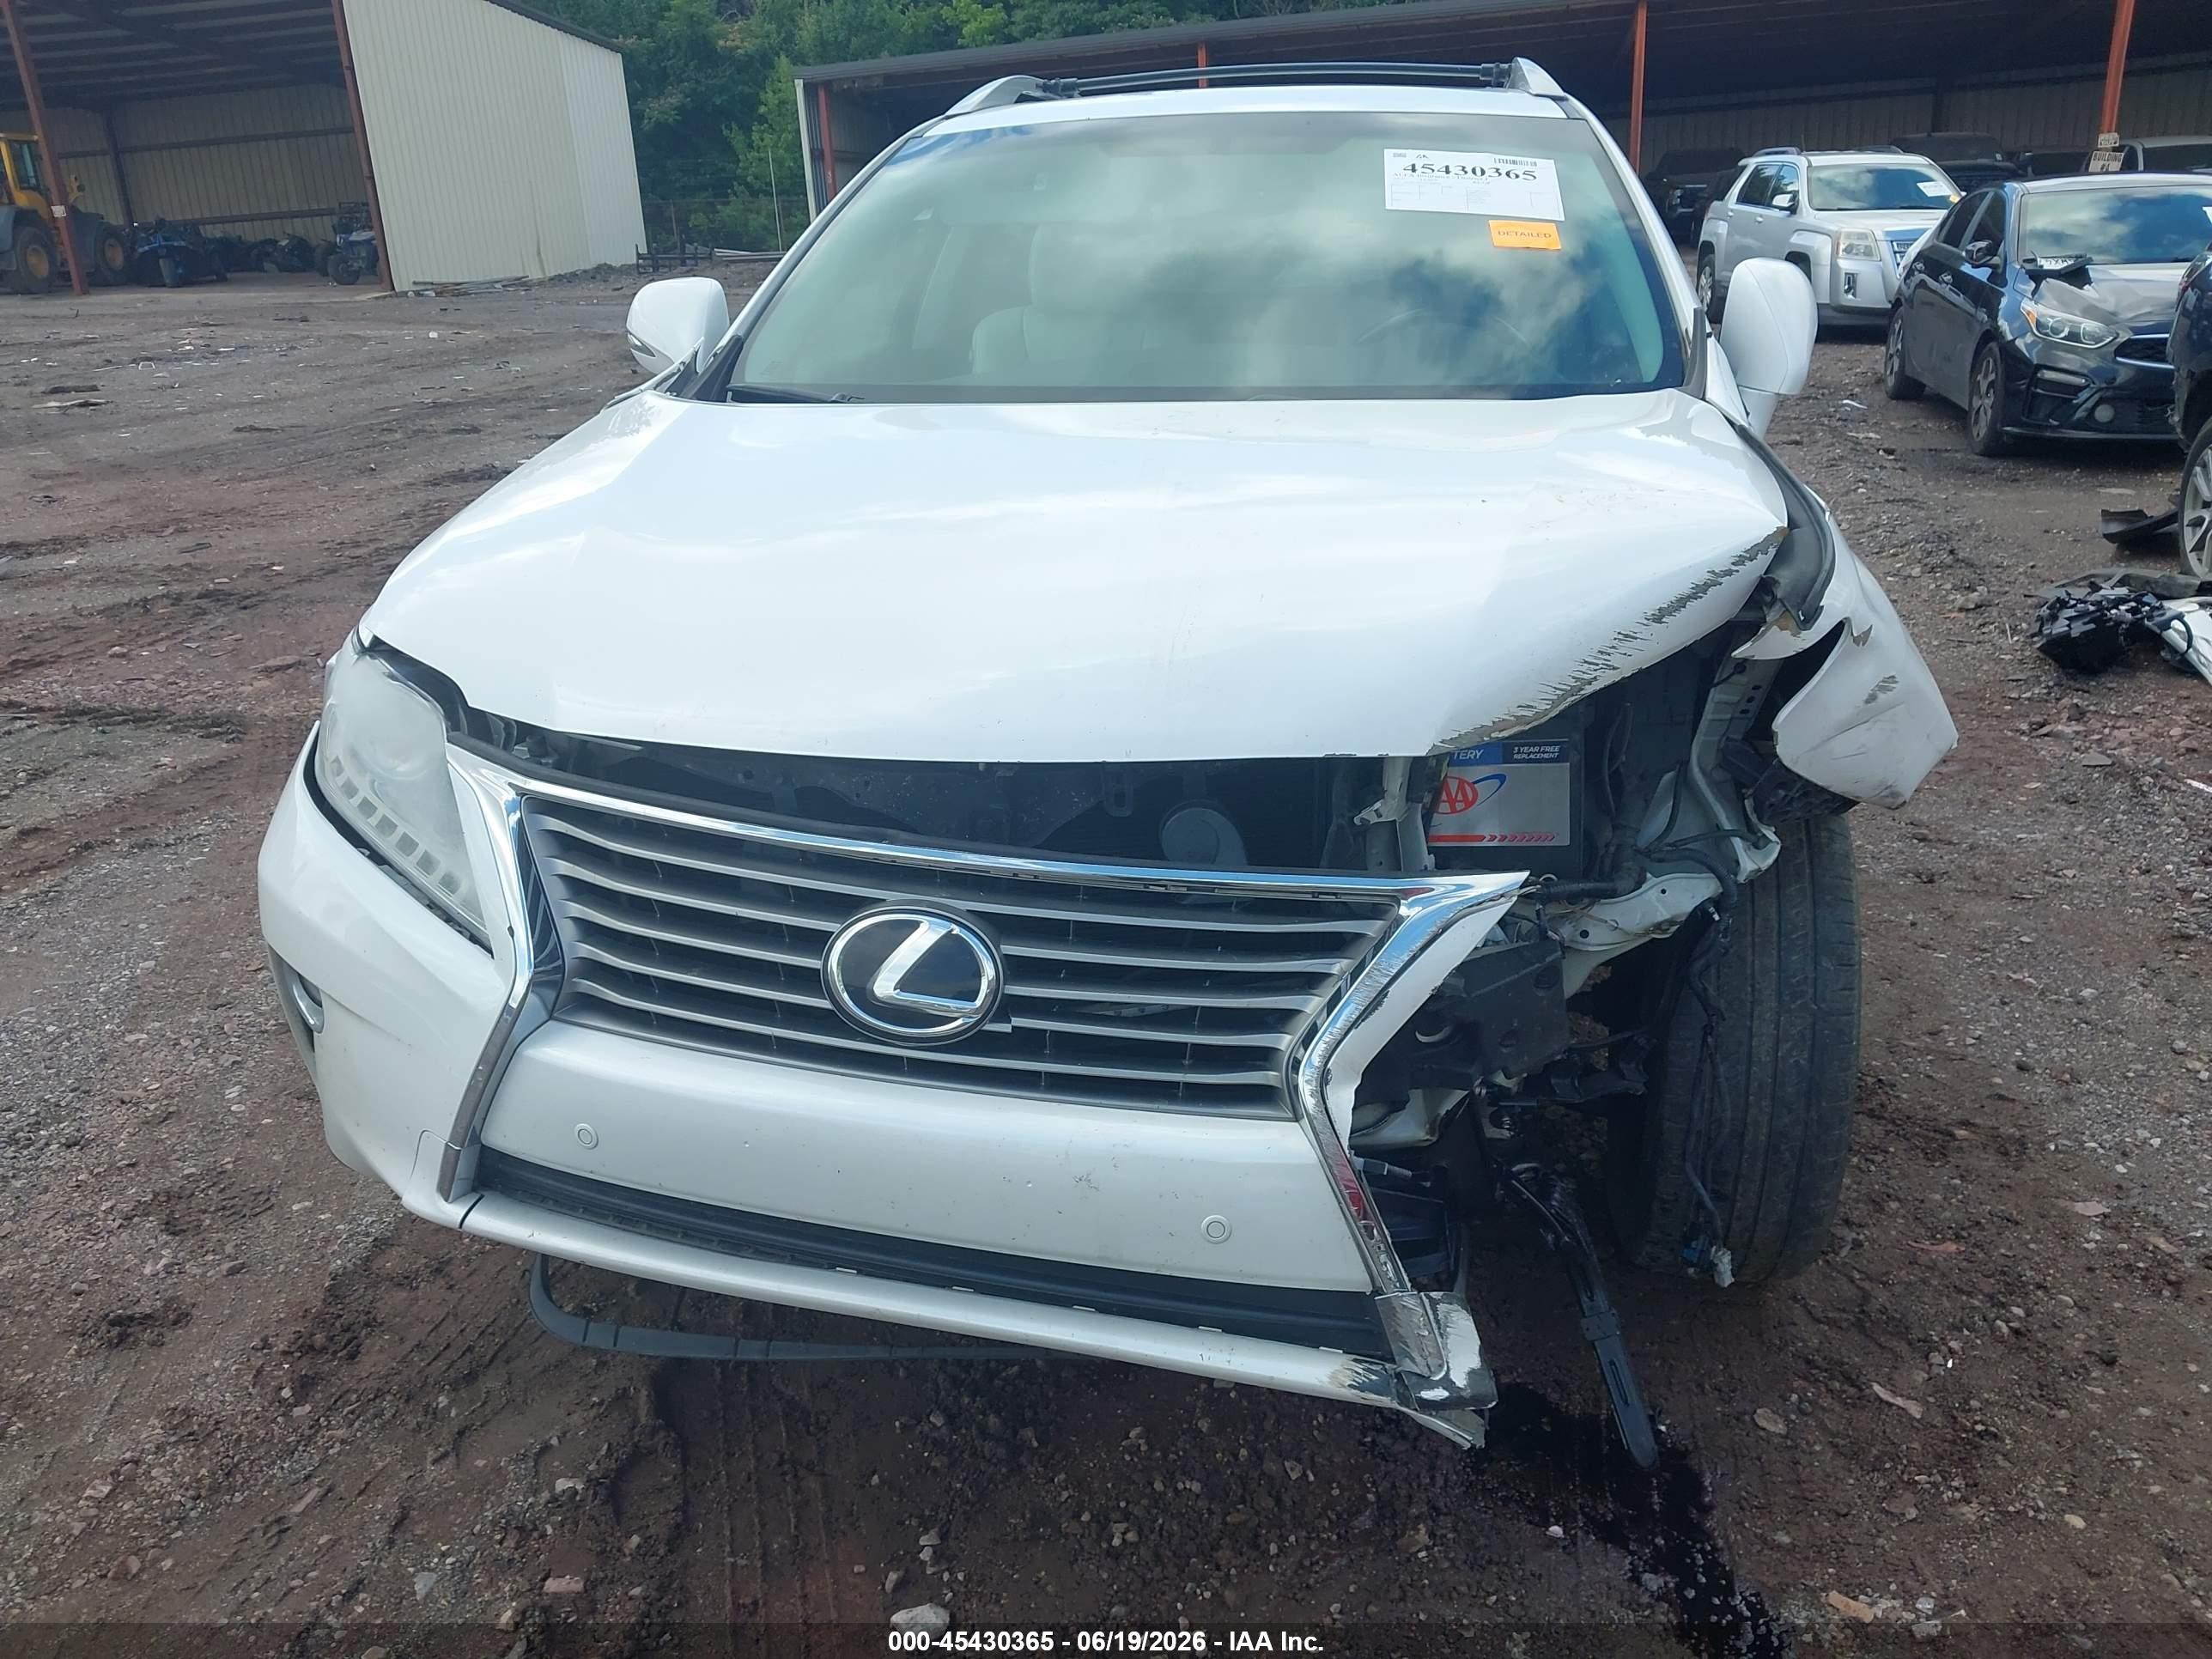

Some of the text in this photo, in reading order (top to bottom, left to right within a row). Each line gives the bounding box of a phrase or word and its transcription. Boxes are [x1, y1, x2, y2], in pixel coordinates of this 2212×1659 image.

[2094, 152, 2123, 162] BUILDING
[1402, 162, 1537, 181] 45430365
[1498, 229, 1553, 239] DETAILED
